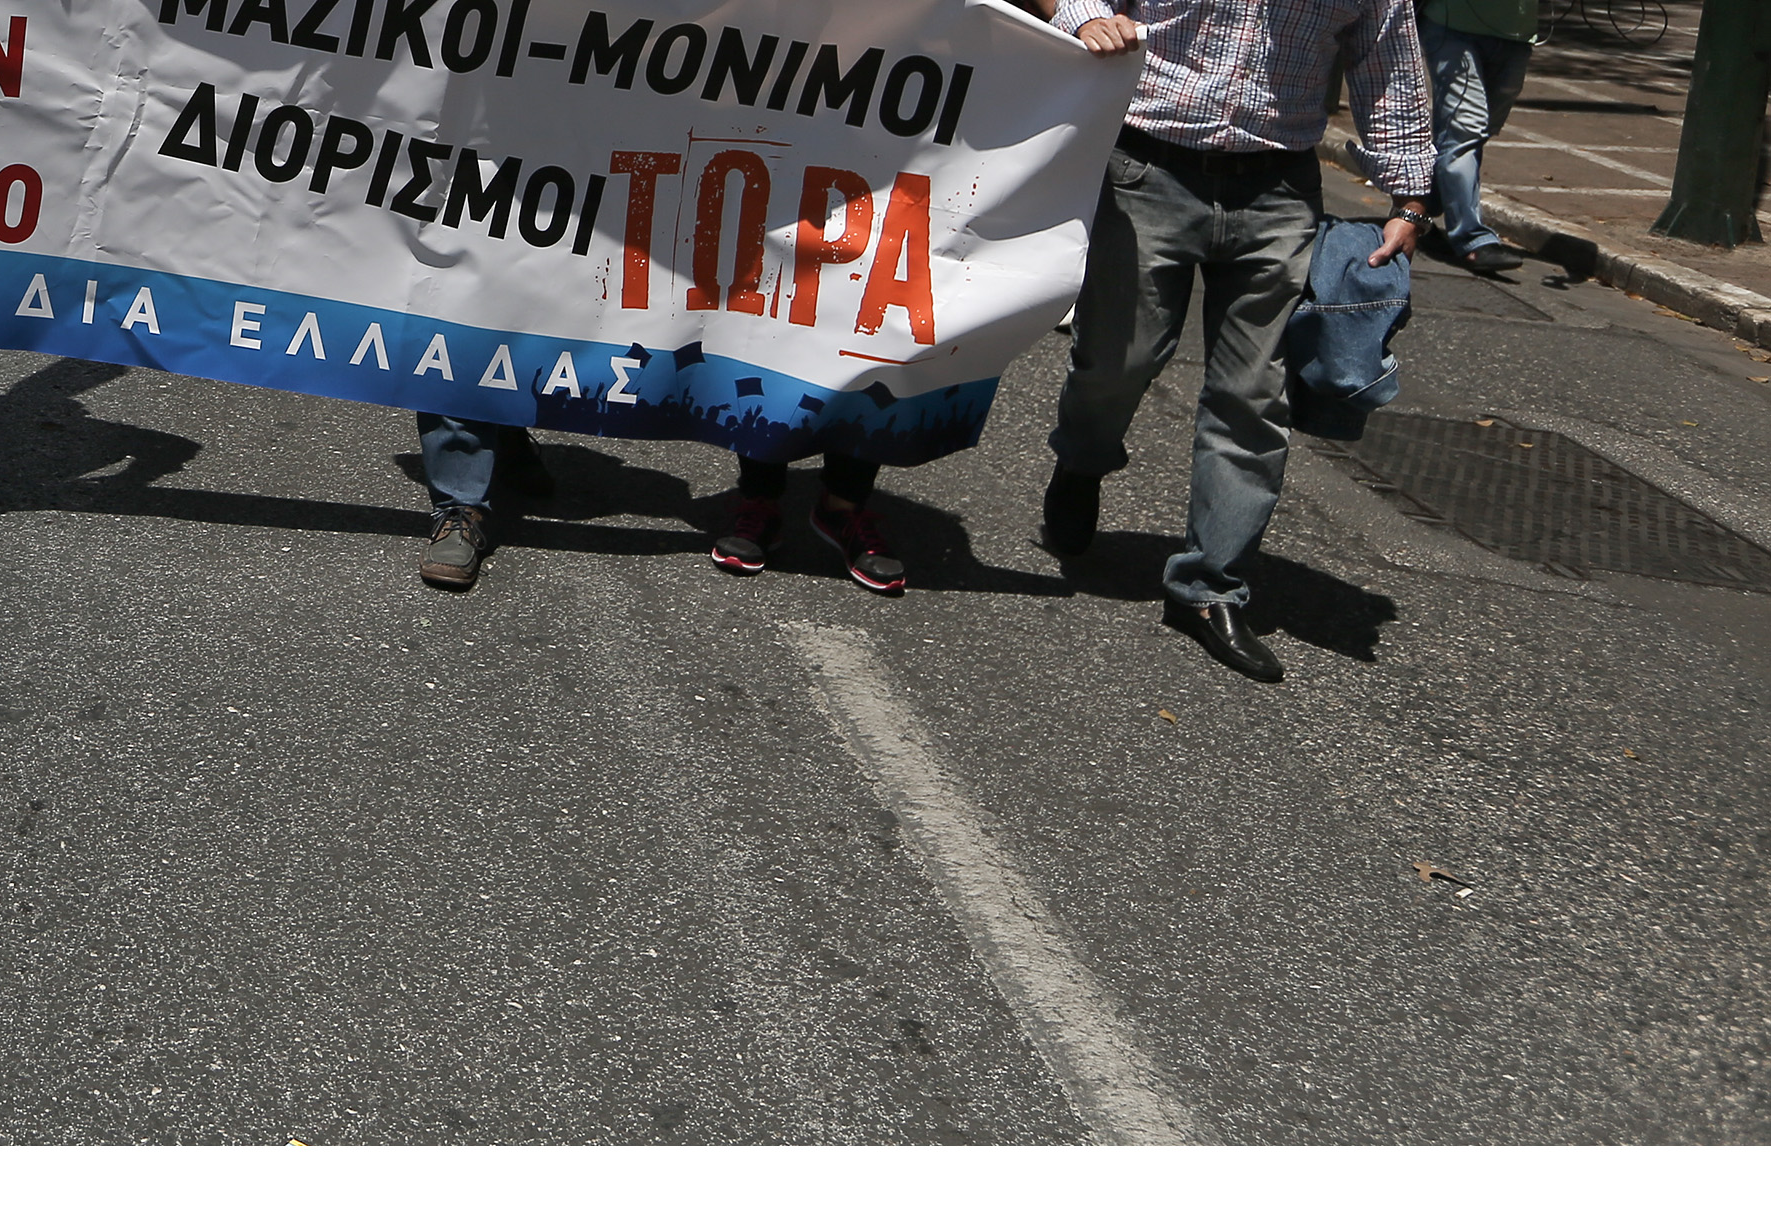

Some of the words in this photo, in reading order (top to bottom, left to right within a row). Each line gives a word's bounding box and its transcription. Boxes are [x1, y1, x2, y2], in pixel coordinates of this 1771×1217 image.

[158, 80, 608, 257] ΔΙΟΡΙΣΜΟΙ
[609, 146, 935, 345] ΤΩΡΑ
[229, 301, 644, 405] ΕΛΛΑΔΑΣ
